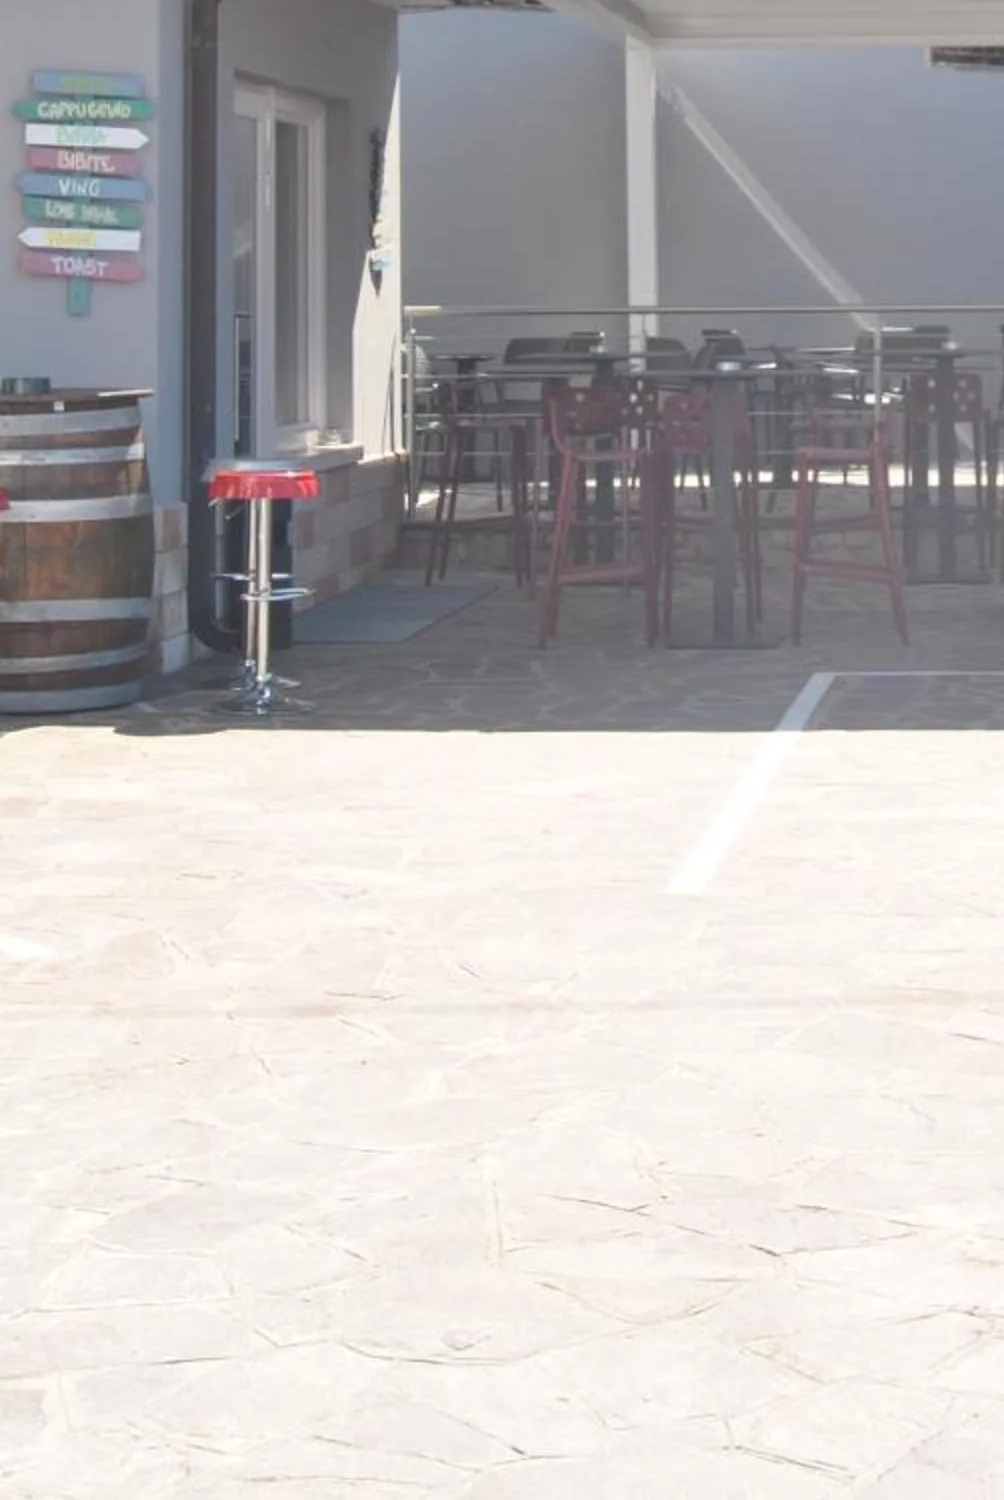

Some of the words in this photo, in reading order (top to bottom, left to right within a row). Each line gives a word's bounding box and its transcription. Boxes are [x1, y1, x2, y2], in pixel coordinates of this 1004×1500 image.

[57, 149, 116, 172] BIBITE
[58, 179, 100, 197] VINO
[52, 256, 109, 277] TOAST
